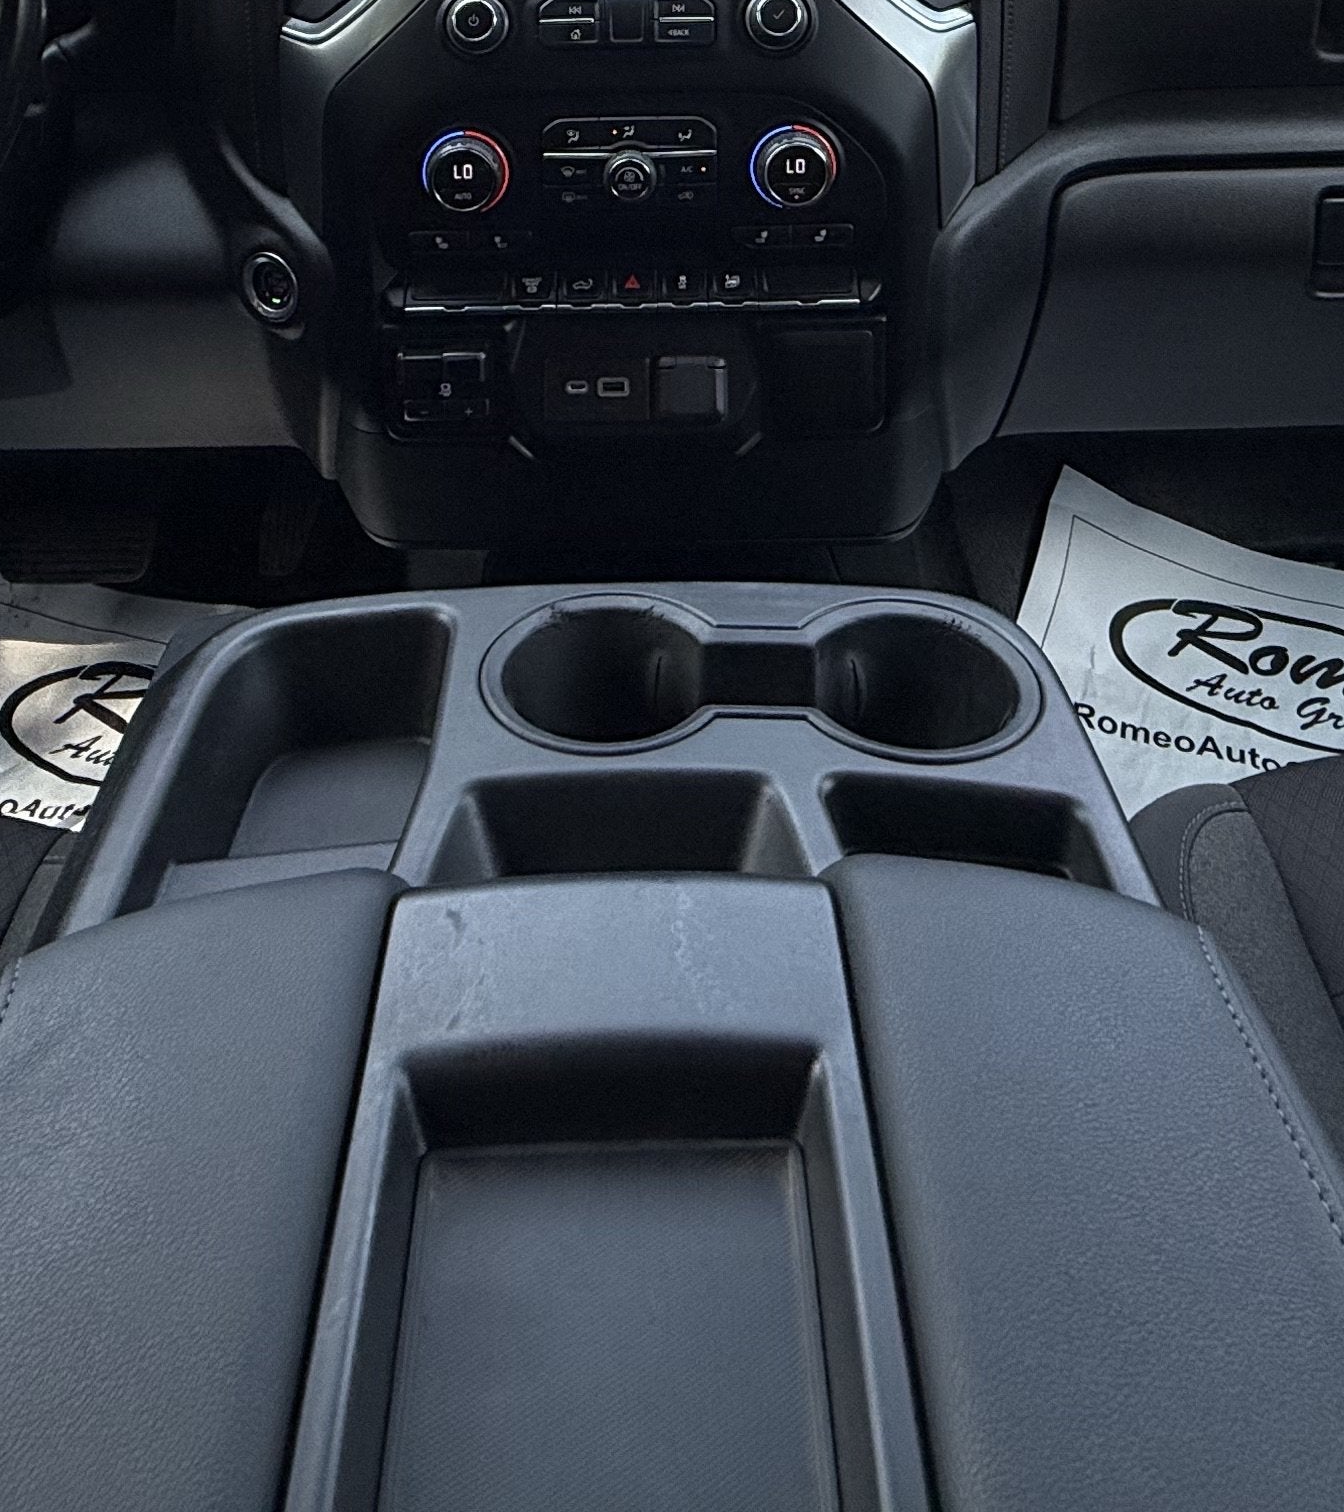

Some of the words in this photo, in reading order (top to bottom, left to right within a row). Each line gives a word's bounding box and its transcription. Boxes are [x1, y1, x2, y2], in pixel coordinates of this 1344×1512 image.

[673, 28, 689, 36] BACK
[453, 163, 473, 180] LO
[680, 165, 694, 174] A/C
[786, 158, 806, 175] LO
[1186, 673, 1280, 711] Auto
[1074, 702, 1299, 772] RomeoAuto
